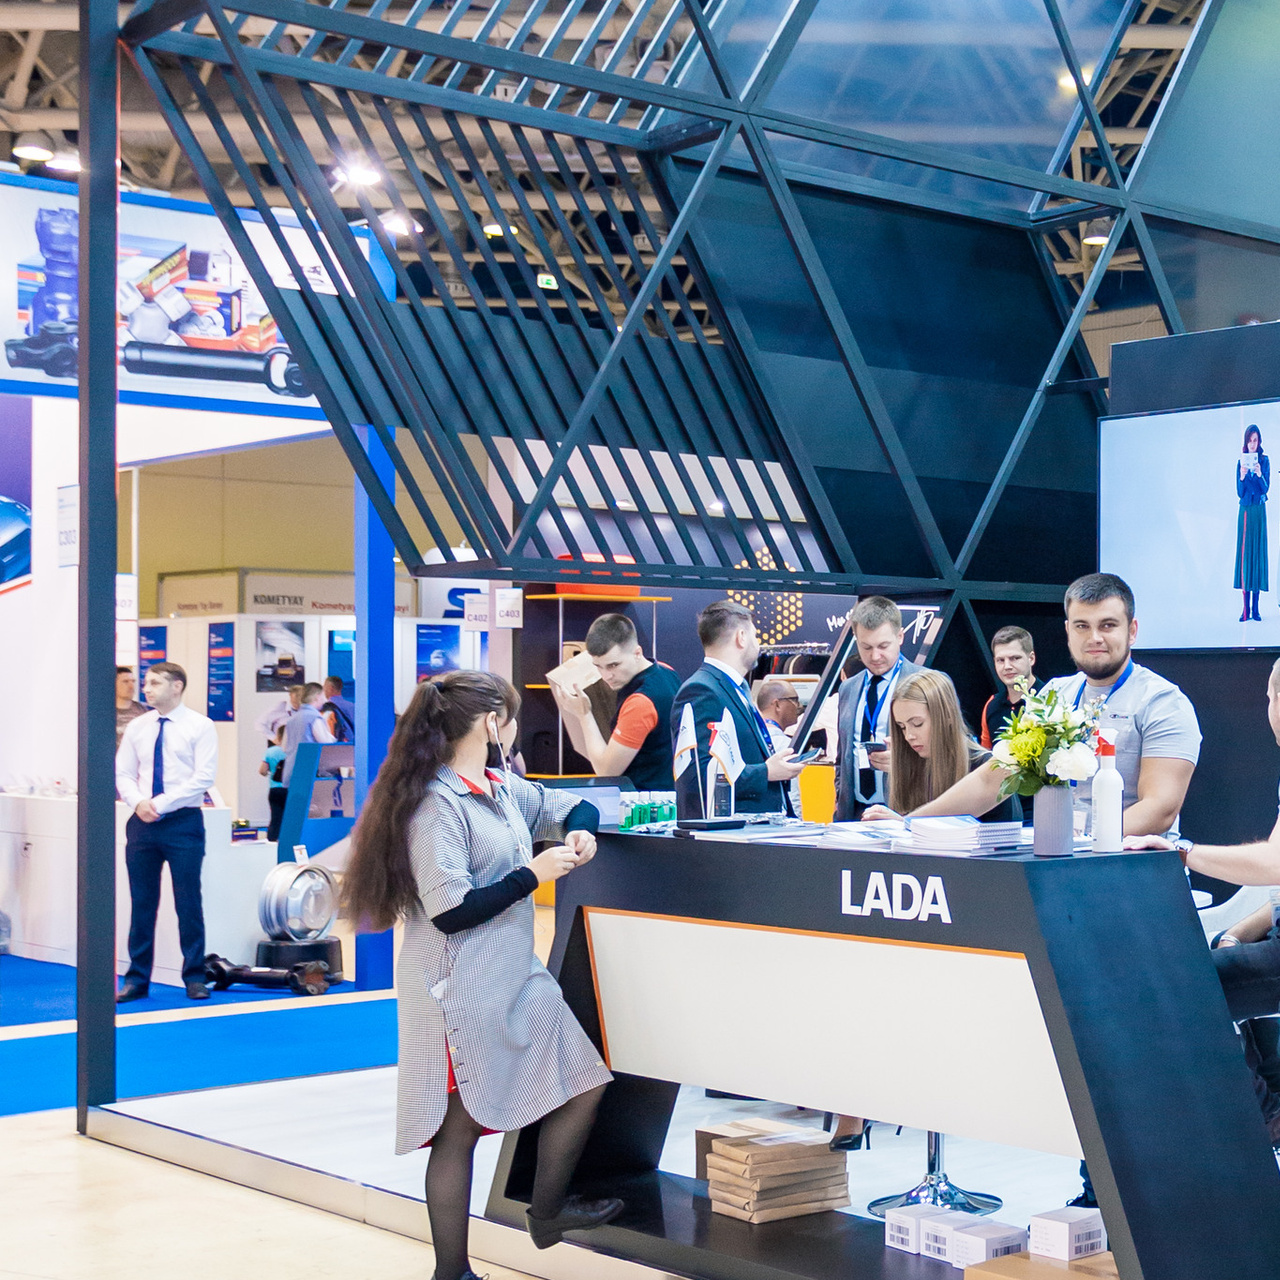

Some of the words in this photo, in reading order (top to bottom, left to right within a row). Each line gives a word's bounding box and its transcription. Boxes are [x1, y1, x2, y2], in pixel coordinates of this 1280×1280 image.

[467, 613, 488, 623] C402
[498, 609, 521, 619] C403
[841, 869, 952, 924] LADA
